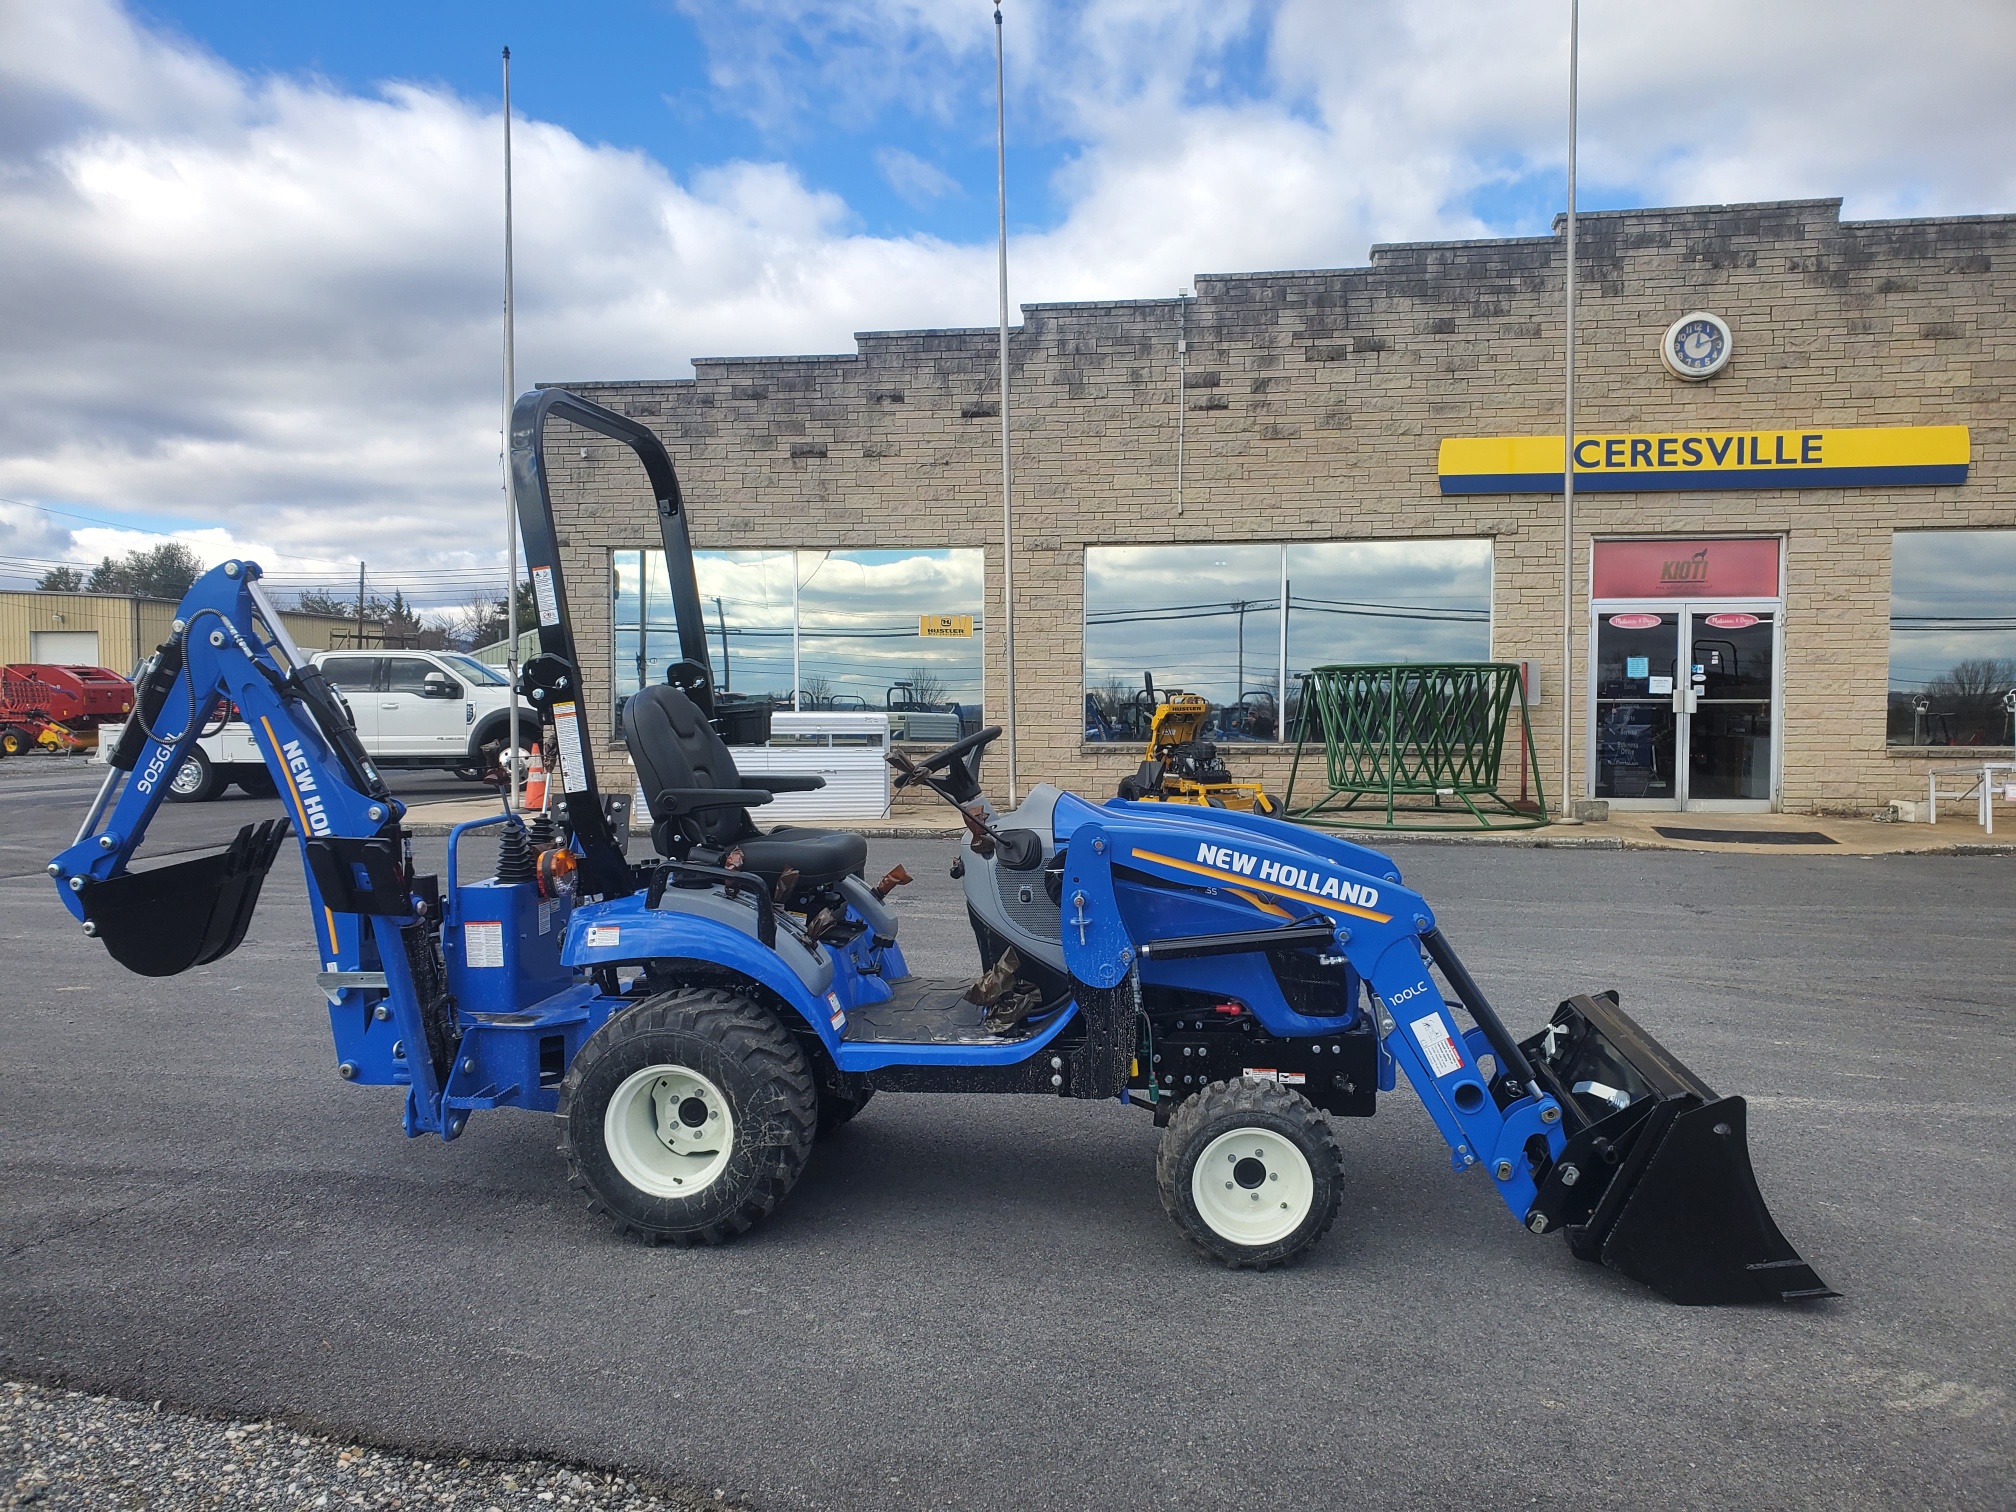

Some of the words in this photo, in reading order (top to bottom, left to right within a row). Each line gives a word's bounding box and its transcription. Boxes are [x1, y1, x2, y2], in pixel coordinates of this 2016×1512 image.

[1686, 325, 1692, 334] 11
[1694, 323, 1702, 331] 12
[1678, 333, 1686, 341] 10
[1675, 343, 1680, 351] 9
[1716, 341, 1722, 349] 3
[1678, 352, 1683, 360] 8
[1685, 358, 1692, 366] 7
[1573, 434, 1823, 468] CERESVILLE
[1660, 560, 1709, 580] KIOTI
[282, 739, 317, 792] NEW
[1196, 842, 1257, 875] NEW
[1259, 859, 1379, 908] HOLLAND
[1388, 980, 1428, 1006] 100LC
